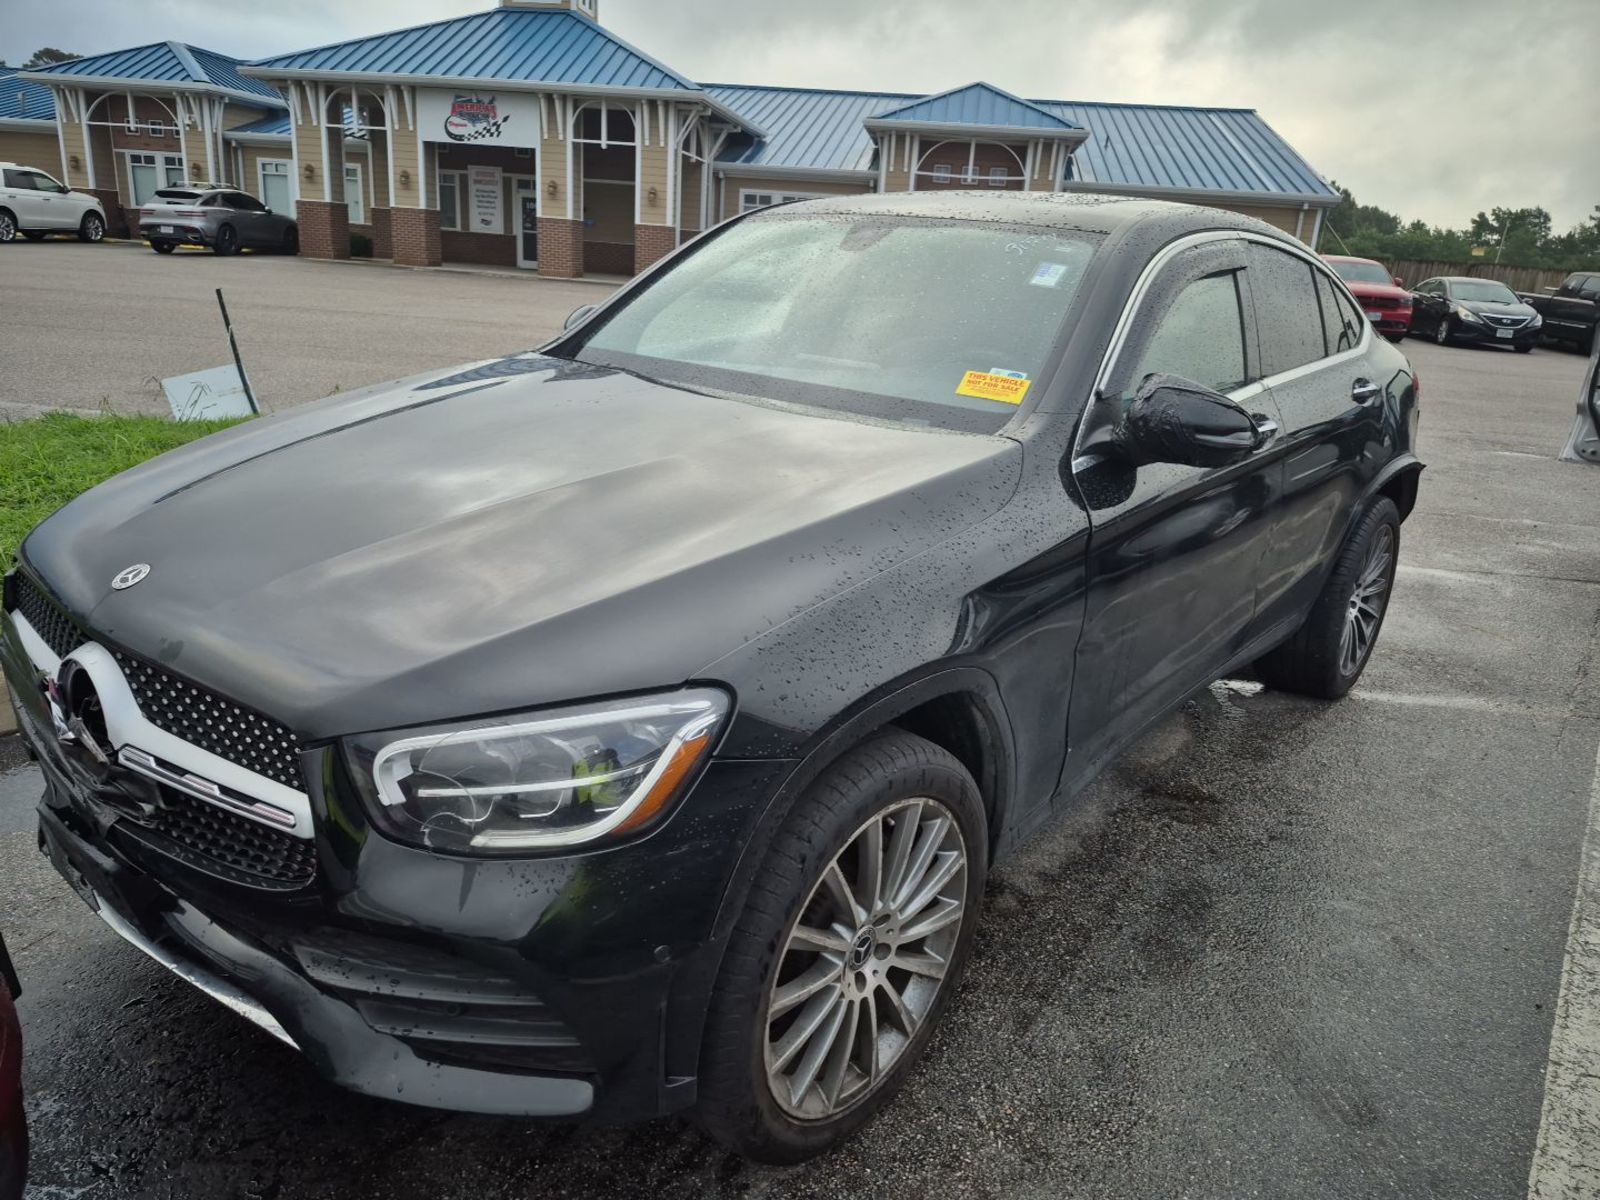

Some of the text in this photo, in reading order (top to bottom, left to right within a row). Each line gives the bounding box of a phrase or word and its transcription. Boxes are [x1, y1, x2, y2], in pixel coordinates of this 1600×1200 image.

[969, 372, 1025, 387] THIS VEHICLE
[1000, 384, 1021, 392] SALE
